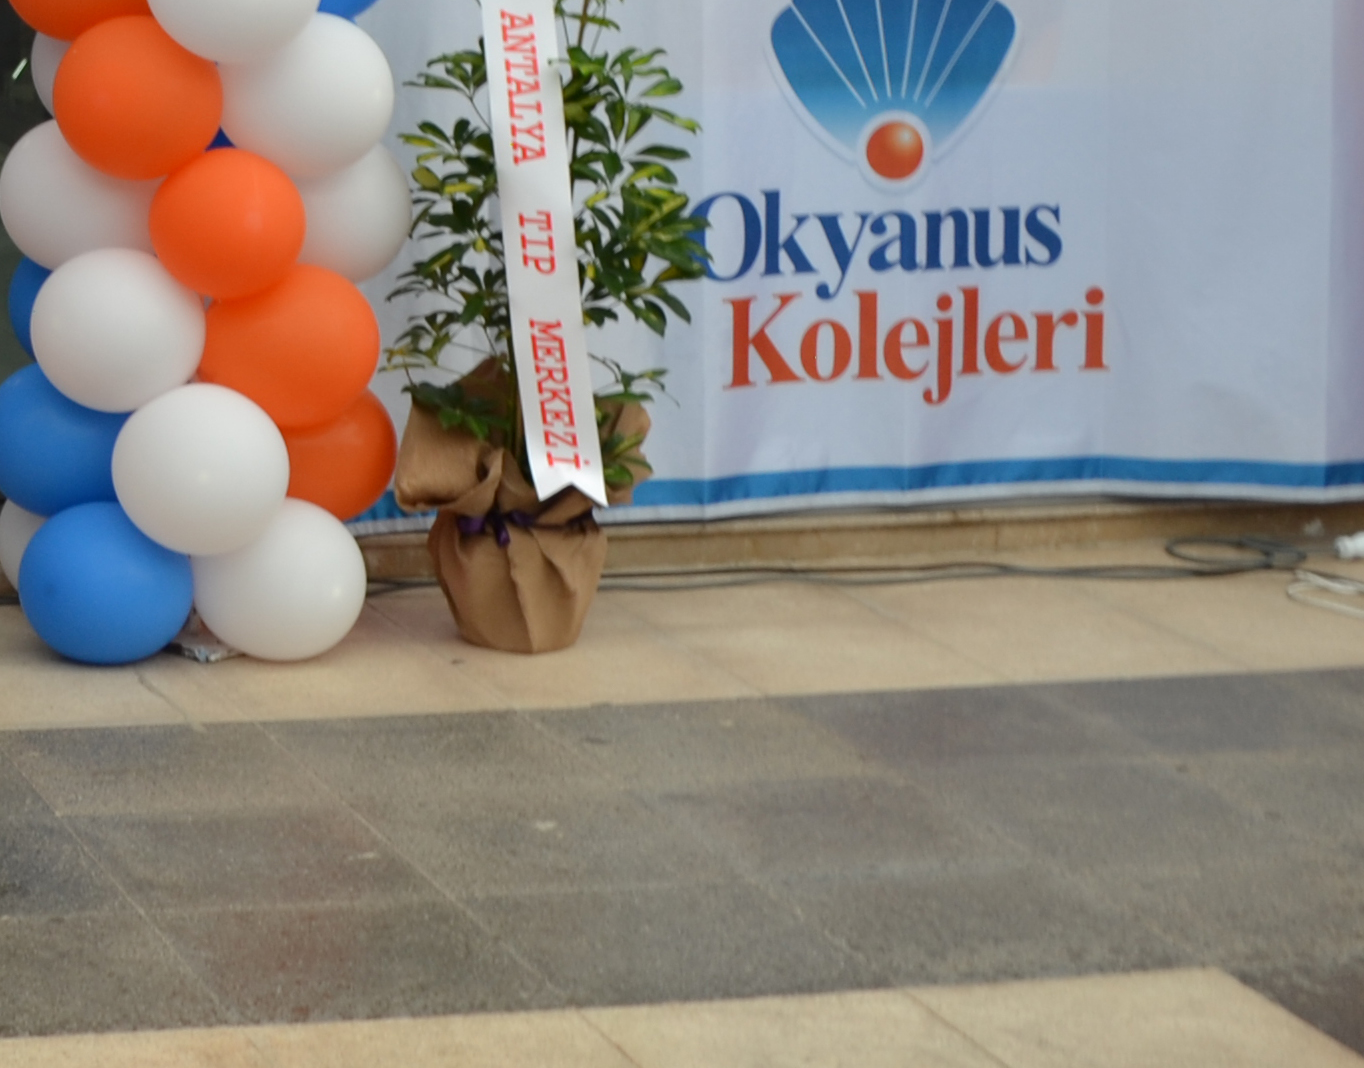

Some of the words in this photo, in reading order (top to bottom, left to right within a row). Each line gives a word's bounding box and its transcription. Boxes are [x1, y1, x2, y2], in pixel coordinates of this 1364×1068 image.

[500, 9, 547, 166] ANTALYA
[518, 210, 557, 275] TIP
[685, 189, 1064, 301] Okyanus
[528, 318, 591, 471] MERKEZİ
[721, 284, 1112, 407] Kolejleri
